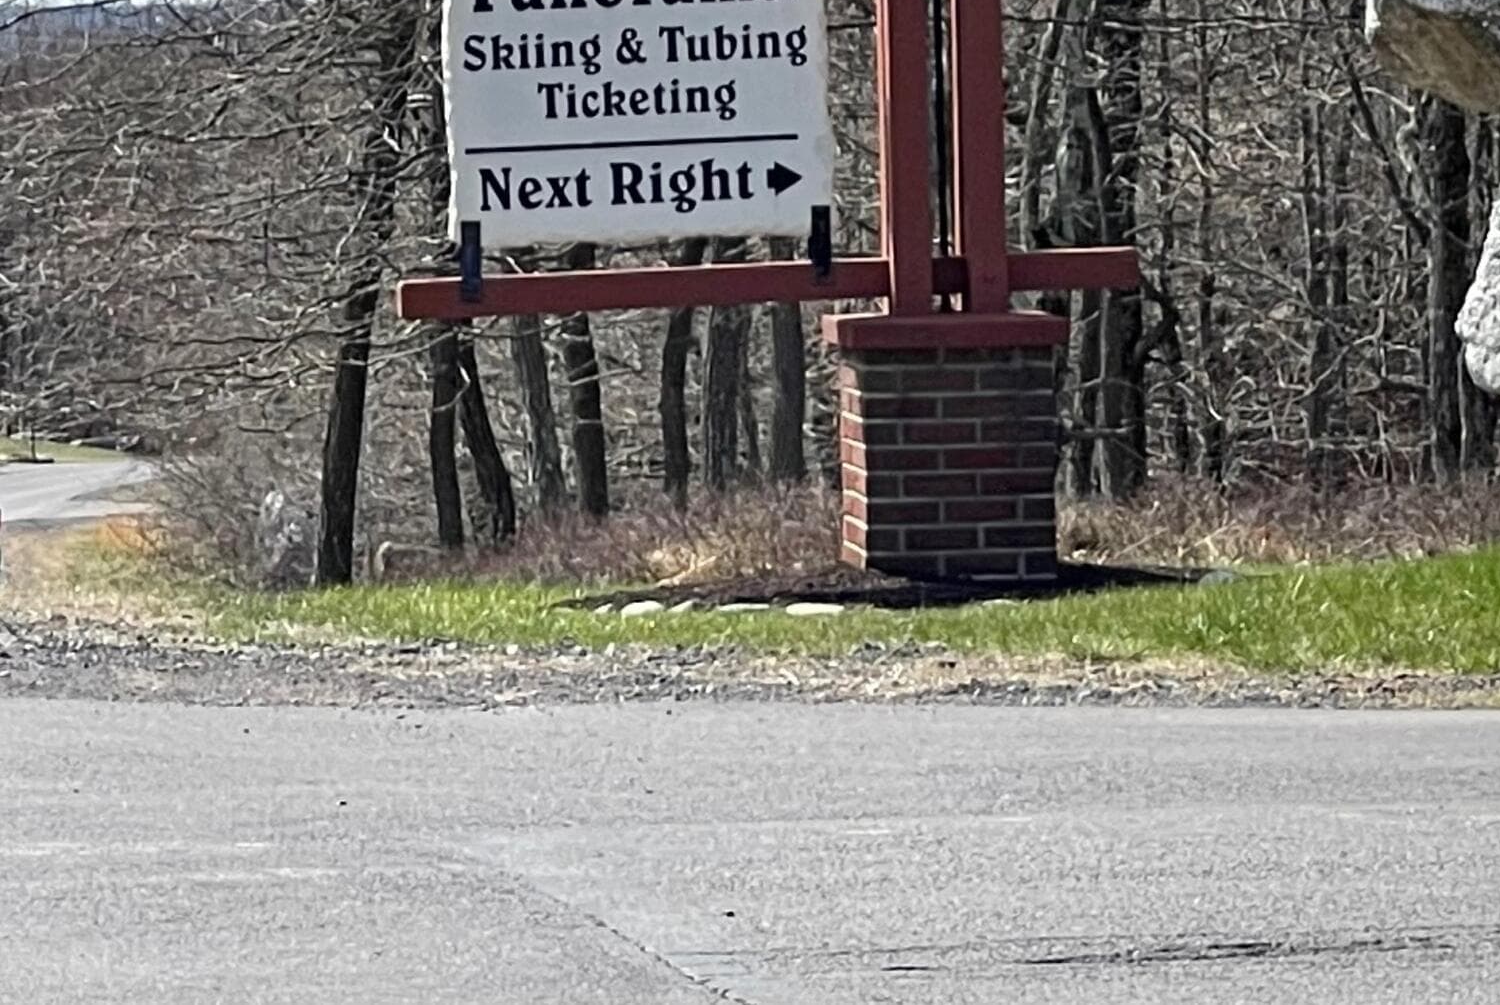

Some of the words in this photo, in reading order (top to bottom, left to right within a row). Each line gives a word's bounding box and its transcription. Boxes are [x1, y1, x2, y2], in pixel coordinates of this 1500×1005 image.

[463, 31, 602, 76] Skiing
[615, 27, 648, 66] &
[658, 23, 808, 67] Tubing
[536, 78, 737, 121] Ticketing
[478, 166, 593, 212] Next
[609, 157, 755, 214] Right
